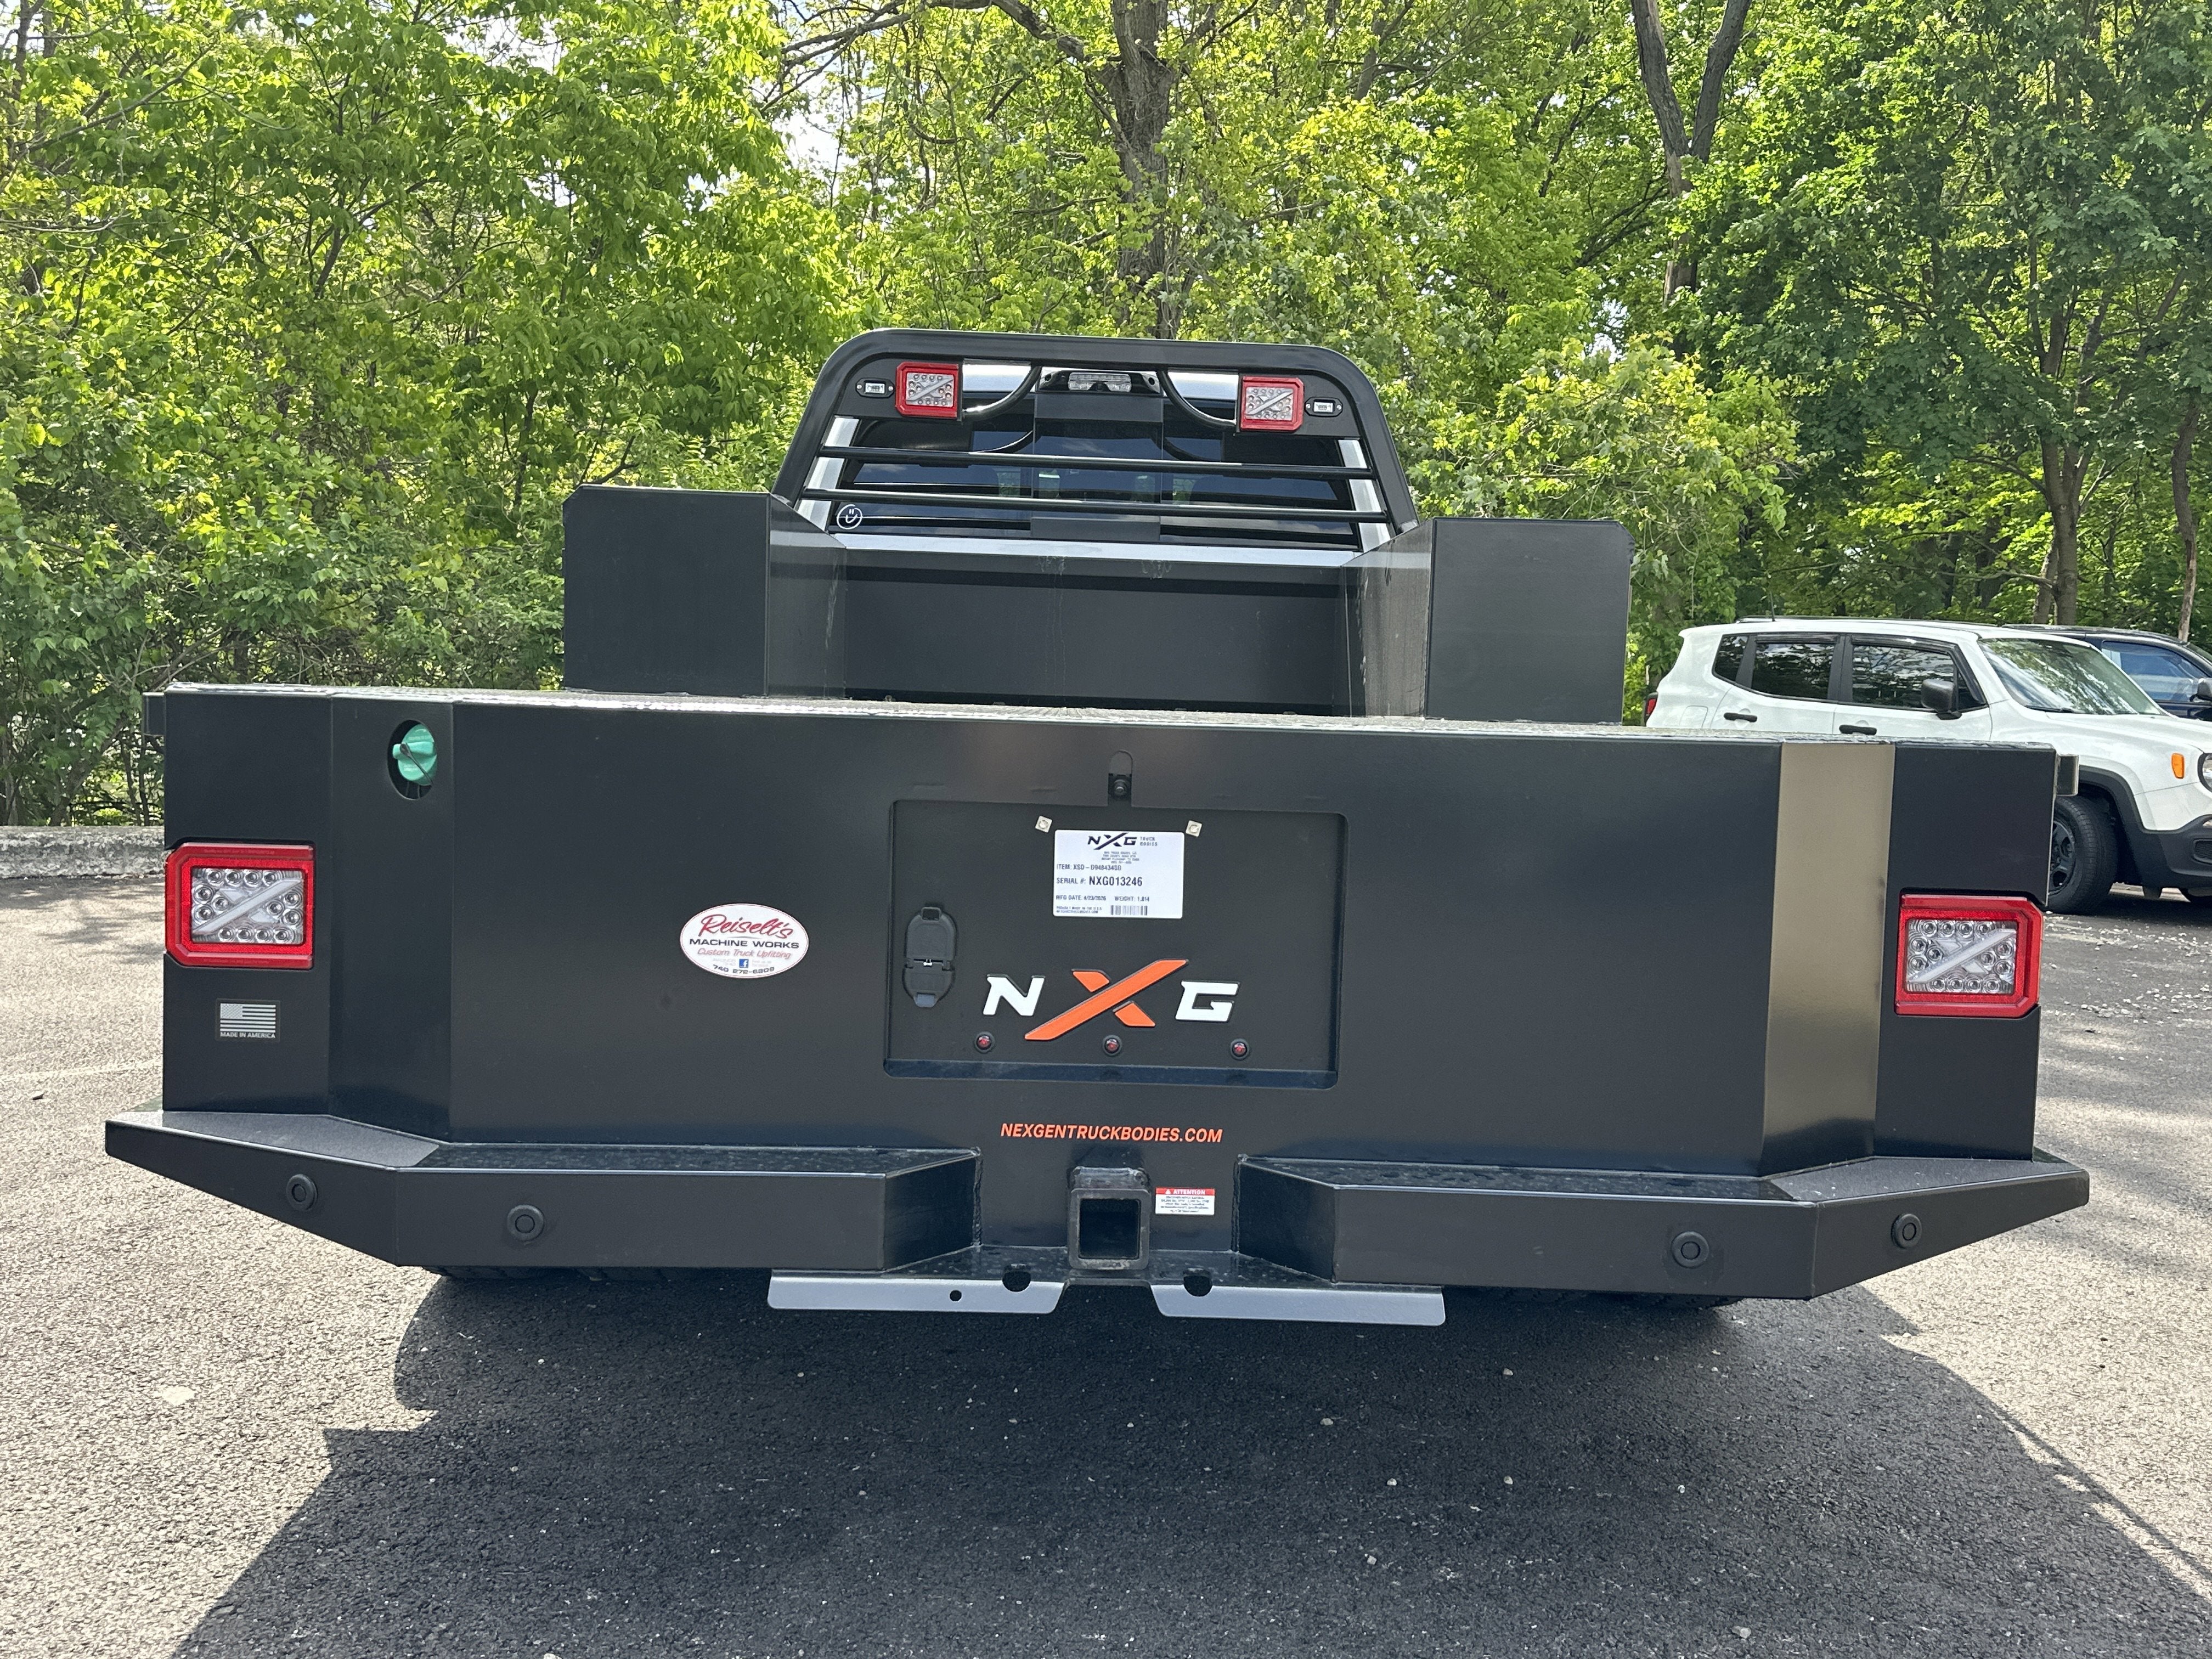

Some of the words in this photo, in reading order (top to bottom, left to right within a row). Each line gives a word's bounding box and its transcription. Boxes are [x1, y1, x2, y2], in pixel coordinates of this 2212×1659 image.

[1087, 832, 1138, 850] NXG
[1089, 876, 1143, 887] NXG013246
[689, 938, 748, 947] MACHINE
[753, 940, 799, 949] WORKS
[697, 948, 730, 956] Custom
[733, 949, 755, 957] Truck
[757, 949, 792, 960] Upfitting
[983, 958, 1241, 1041] NXG
[1000, 1122, 1223, 1143] NEXGENTRUCKBODIES.COM
